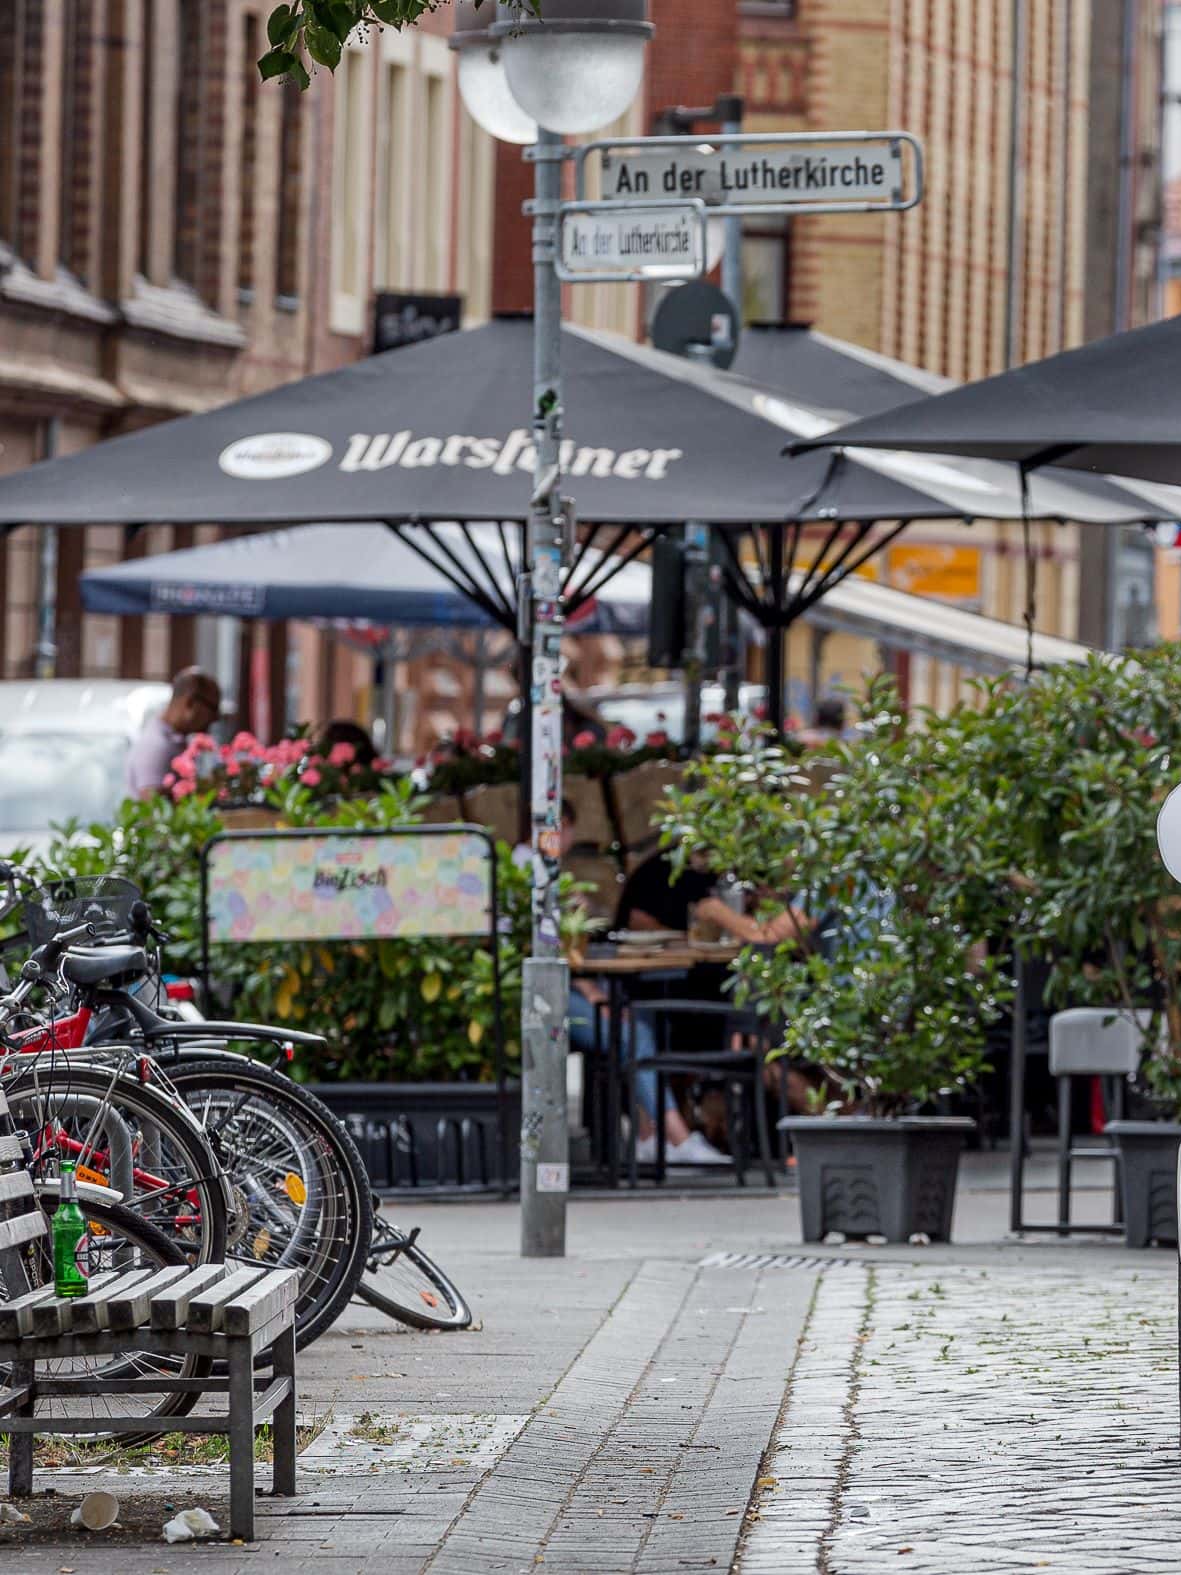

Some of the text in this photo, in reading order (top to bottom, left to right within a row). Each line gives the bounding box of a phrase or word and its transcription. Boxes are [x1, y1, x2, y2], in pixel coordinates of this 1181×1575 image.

[616, 156, 885, 194] An der Lutherkirche
[618, 222, 689, 256] Lutherkirche
